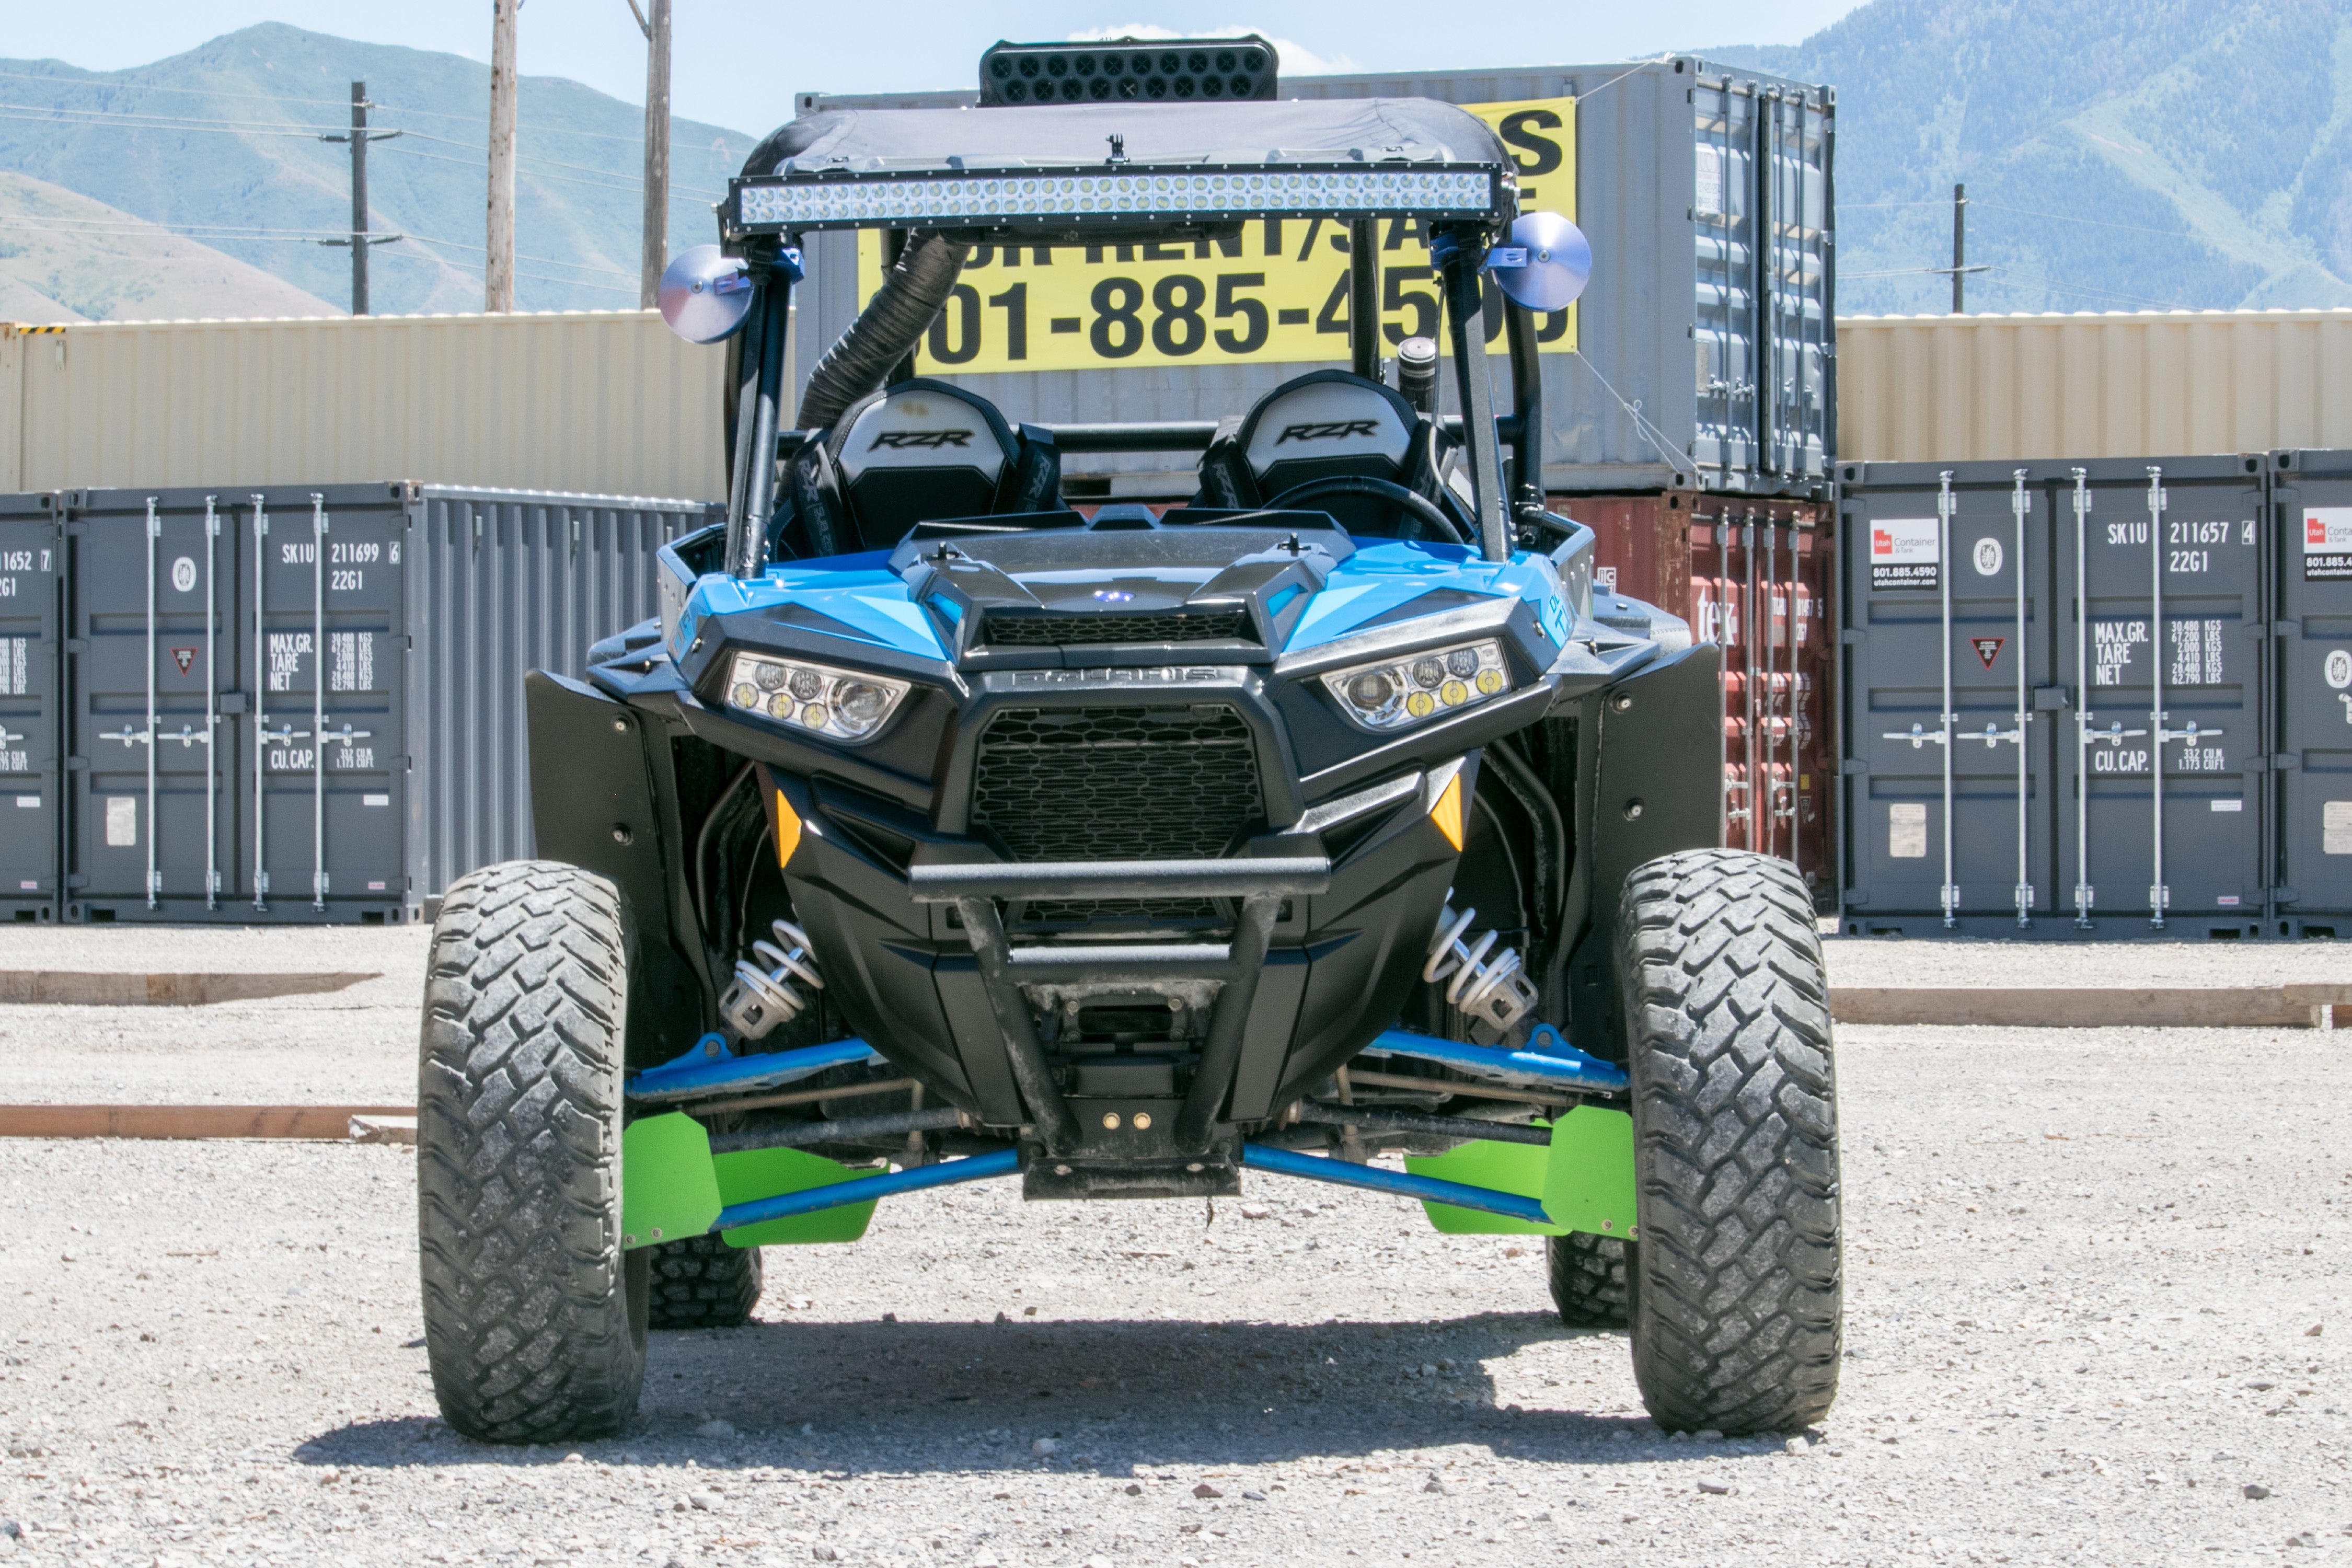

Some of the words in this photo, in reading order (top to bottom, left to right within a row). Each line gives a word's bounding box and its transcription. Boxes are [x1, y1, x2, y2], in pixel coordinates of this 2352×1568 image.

[1273, 420, 1381, 447] RZR
[867, 431, 975, 453] RZR
[2107, 523, 2147, 545] SKIU
[2170, 522, 2229, 544] 211657
[2243, 522, 2254, 544] 4
[2309, 528, 2324, 536] Utah
[1894, 537, 1936, 547] Container
[282, 544, 314, 563] SKIU
[331, 543, 379, 563] 211699
[390, 543, 399, 563] 6
[0, 551, 32, 571] 1652
[42, 549, 50, 570] 7
[2170, 550, 2208, 572] 22G1
[1873, 567, 1937, 578] 801.885.4590
[331, 570, 363, 590] 22G1
[1874, 578, 1936, 586] utahcontainer.com
[2095, 621, 2149, 643] MAX.GR.
[2171, 621, 2199, 632] 30.480
[2205, 620, 2221, 631] KGS
[359, 632, 373, 642] KGS
[2171, 631, 2199, 642] 67.200
[2205, 631, 2220, 641] LBS
[270, 633, 313, 653] MAX.GR.
[359, 642, 373, 652] LBS
[2177, 642, 2199, 653] 2.000
[2205, 641, 2222, 652] KGS
[359, 652, 373, 662] KGS
[2095, 642, 2131, 664] TARE
[2177, 652, 2200, 663] 4.410
[2206, 652, 2221, 662] LBS
[270, 653, 299, 672] TARE
[359, 662, 373, 671] LBS
[2172, 663, 2200, 674] 28.480
[2206, 662, 2222, 673] KGS
[359, 671, 373, 681] KGS
[2096, 664, 2122, 685] NET
[2172, 673, 2200, 684] 62.790
[2206, 673, 2221, 684] LBS
[270, 672, 291, 690] NET
[359, 681, 373, 690] LBS
[271, 749, 314, 769] CU.CAP.
[2095, 750, 2149, 771] CU.CAP.
